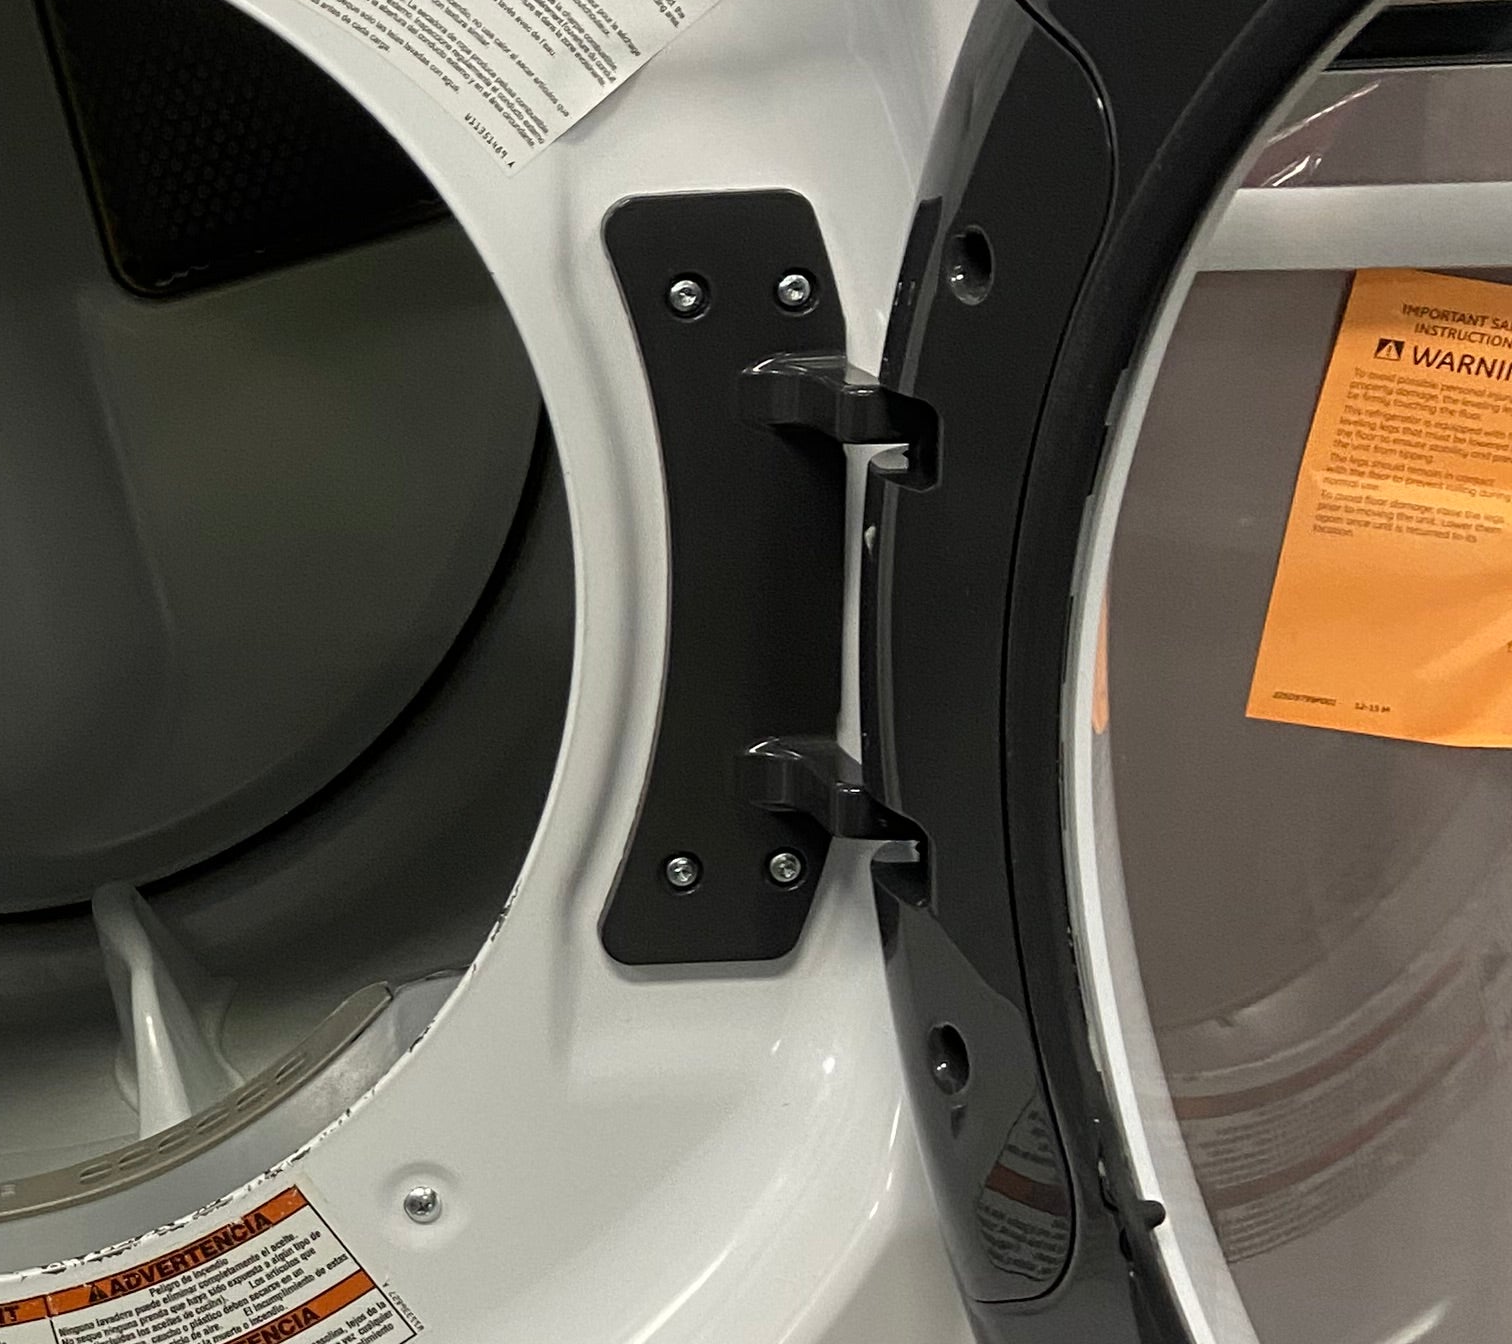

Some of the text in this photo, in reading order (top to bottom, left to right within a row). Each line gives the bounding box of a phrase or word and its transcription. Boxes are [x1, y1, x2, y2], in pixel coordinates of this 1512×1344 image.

[1403, 303, 1512, 331] IMPORTANT SA
[110, 1212, 274, 1297] ADVERTENCIA
[149, 1278, 180, 1297] Peligro
